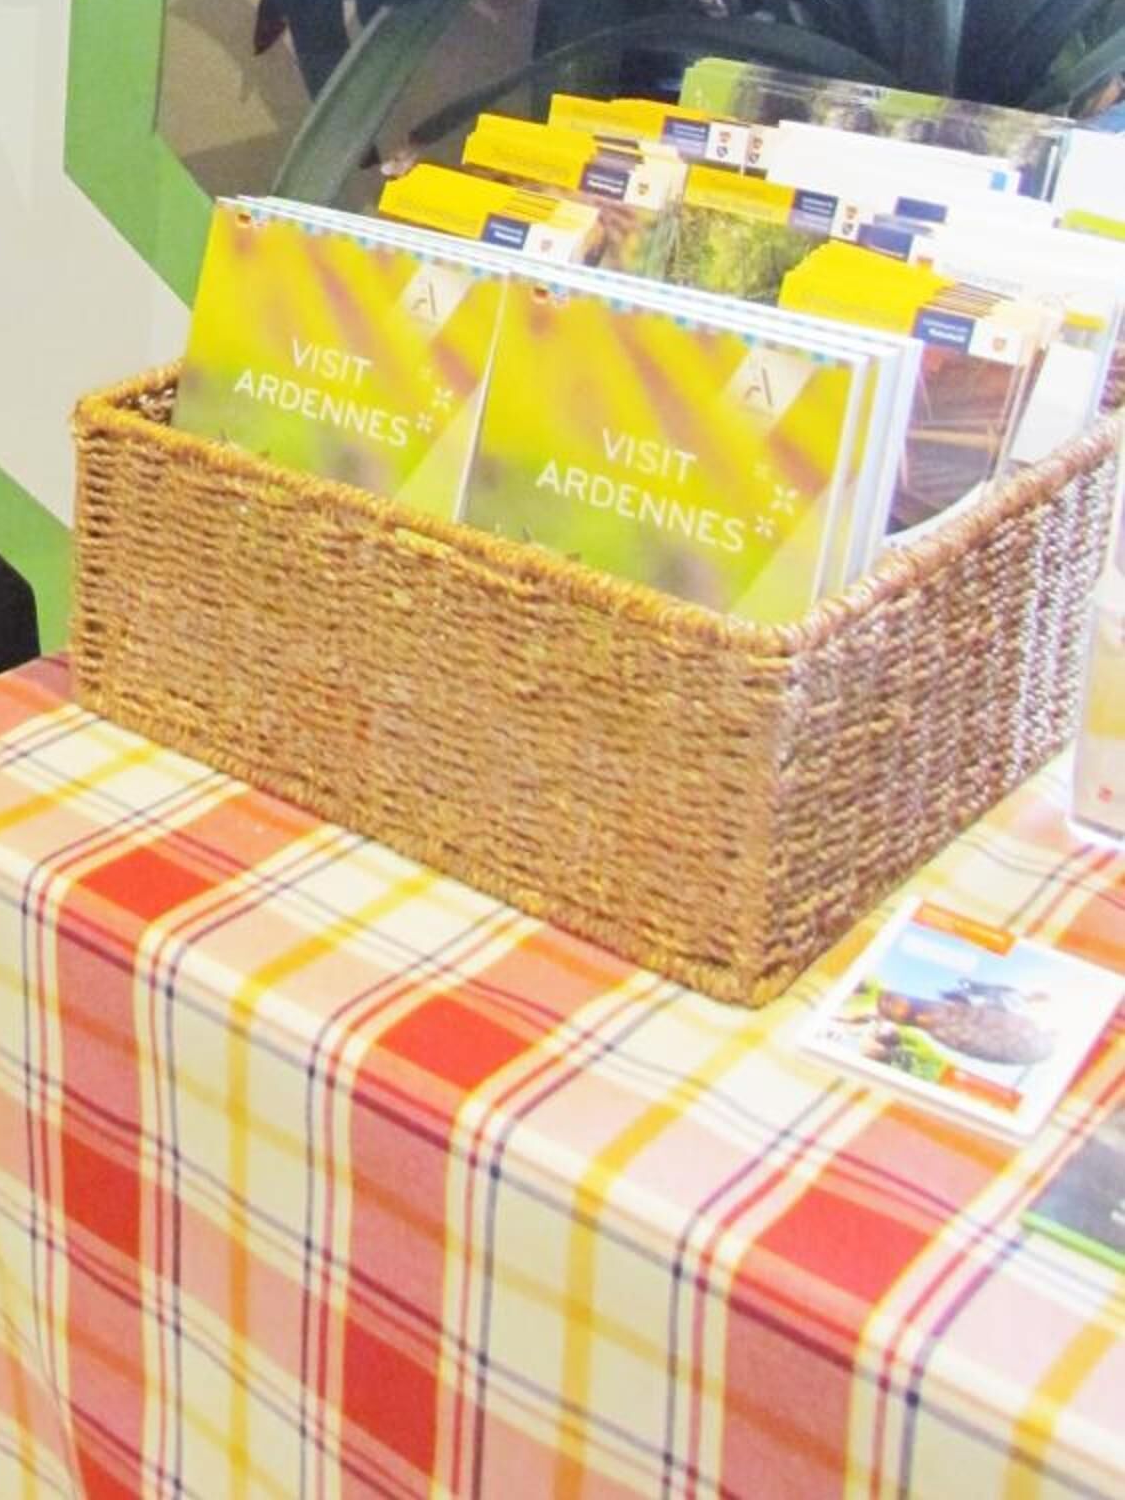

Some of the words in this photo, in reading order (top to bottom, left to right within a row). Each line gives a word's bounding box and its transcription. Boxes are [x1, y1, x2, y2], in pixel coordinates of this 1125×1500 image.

[292, 337, 372, 384] VISIT
[233, 368, 412, 447] ARDENNES
[602, 427, 697, 484] VISIT
[535, 459, 746, 553] ARDENNES
